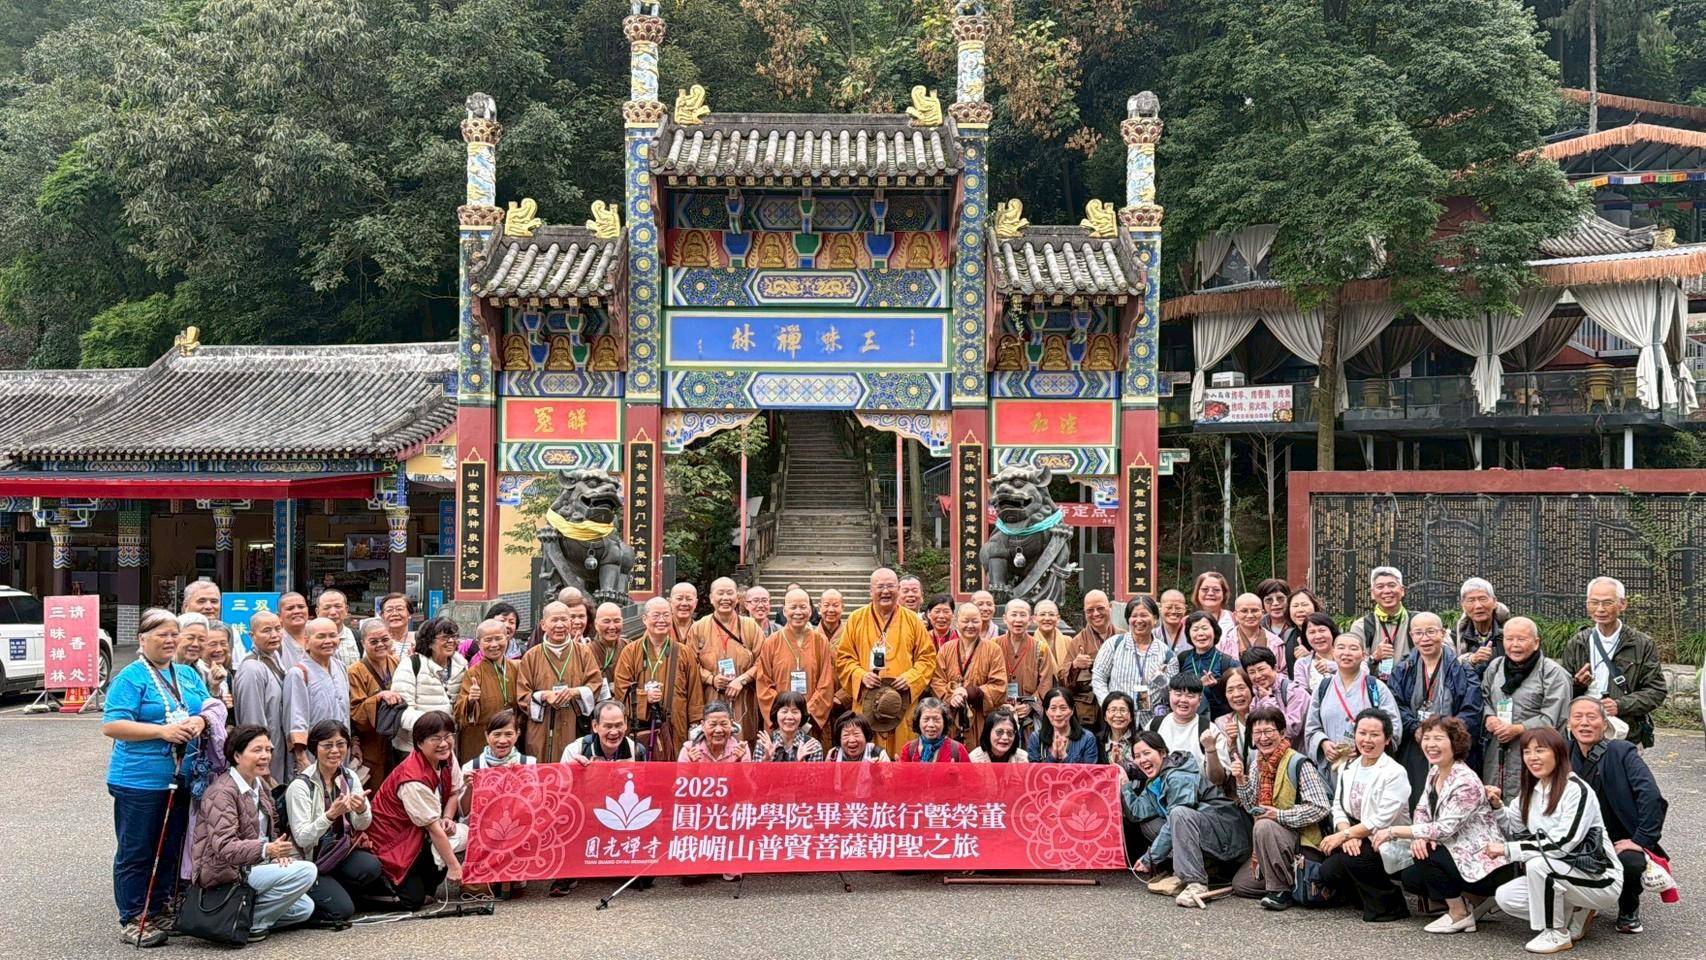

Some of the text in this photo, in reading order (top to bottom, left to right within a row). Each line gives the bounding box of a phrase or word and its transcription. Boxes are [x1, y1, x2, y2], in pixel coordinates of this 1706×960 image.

[48, 606, 67, 683] 三昧禅林
[68, 605, 86, 682] 请香处
[674, 776, 729, 798] 2025
[672, 801, 1007, 832] 圓光佛學院畢業旅行暨榮董
[585, 836, 662, 859] 圓光禪寺
[668, 833, 981, 862] 峨嵋山普賢菩薩朝聖之旅
